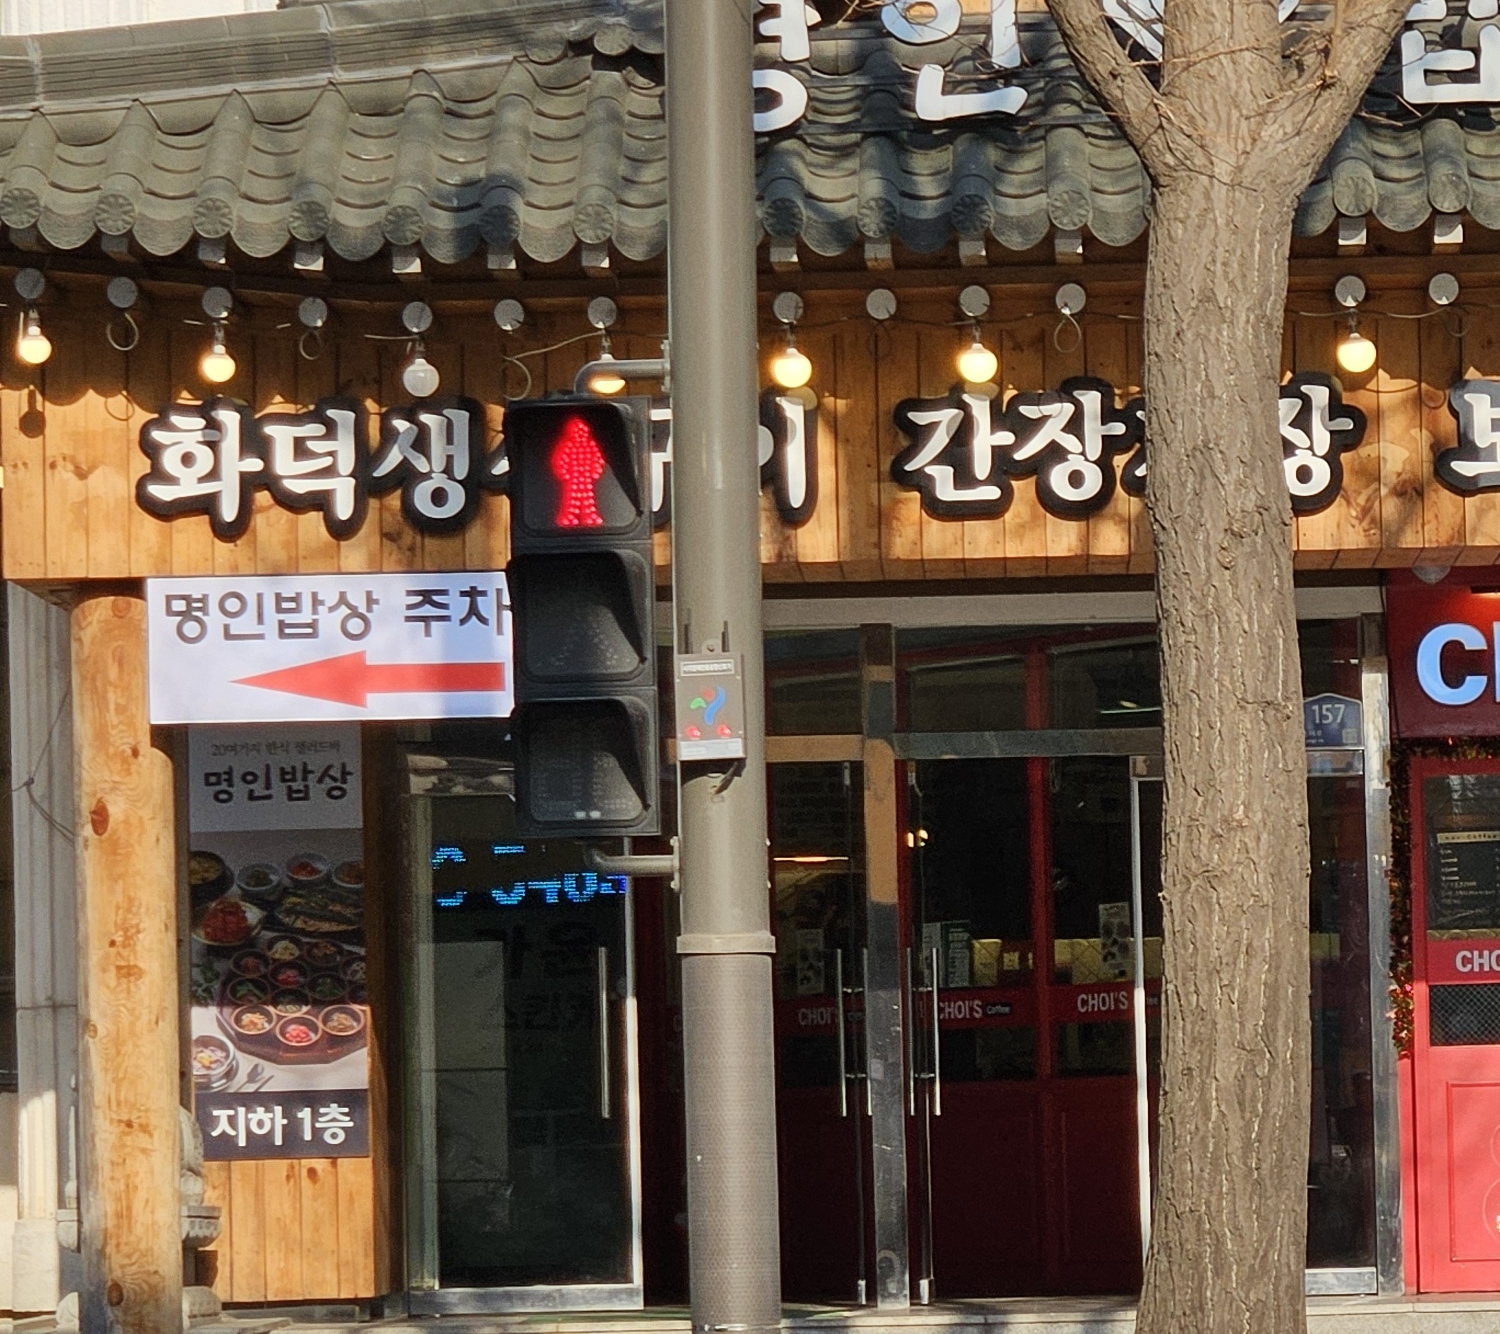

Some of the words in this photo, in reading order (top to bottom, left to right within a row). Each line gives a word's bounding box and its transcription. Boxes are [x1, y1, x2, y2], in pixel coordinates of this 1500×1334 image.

[902, 382, 1355, 503] 간장장
[163, 589, 381, 642] 명인밥상
[1311, 703, 1346, 724] 157
[203, 761, 354, 804] 명인밥상
[1076, 990, 1129, 1014] CHOI'S
[210, 1104, 288, 1147] 지하
[297, 1103, 354, 1146] 1층
